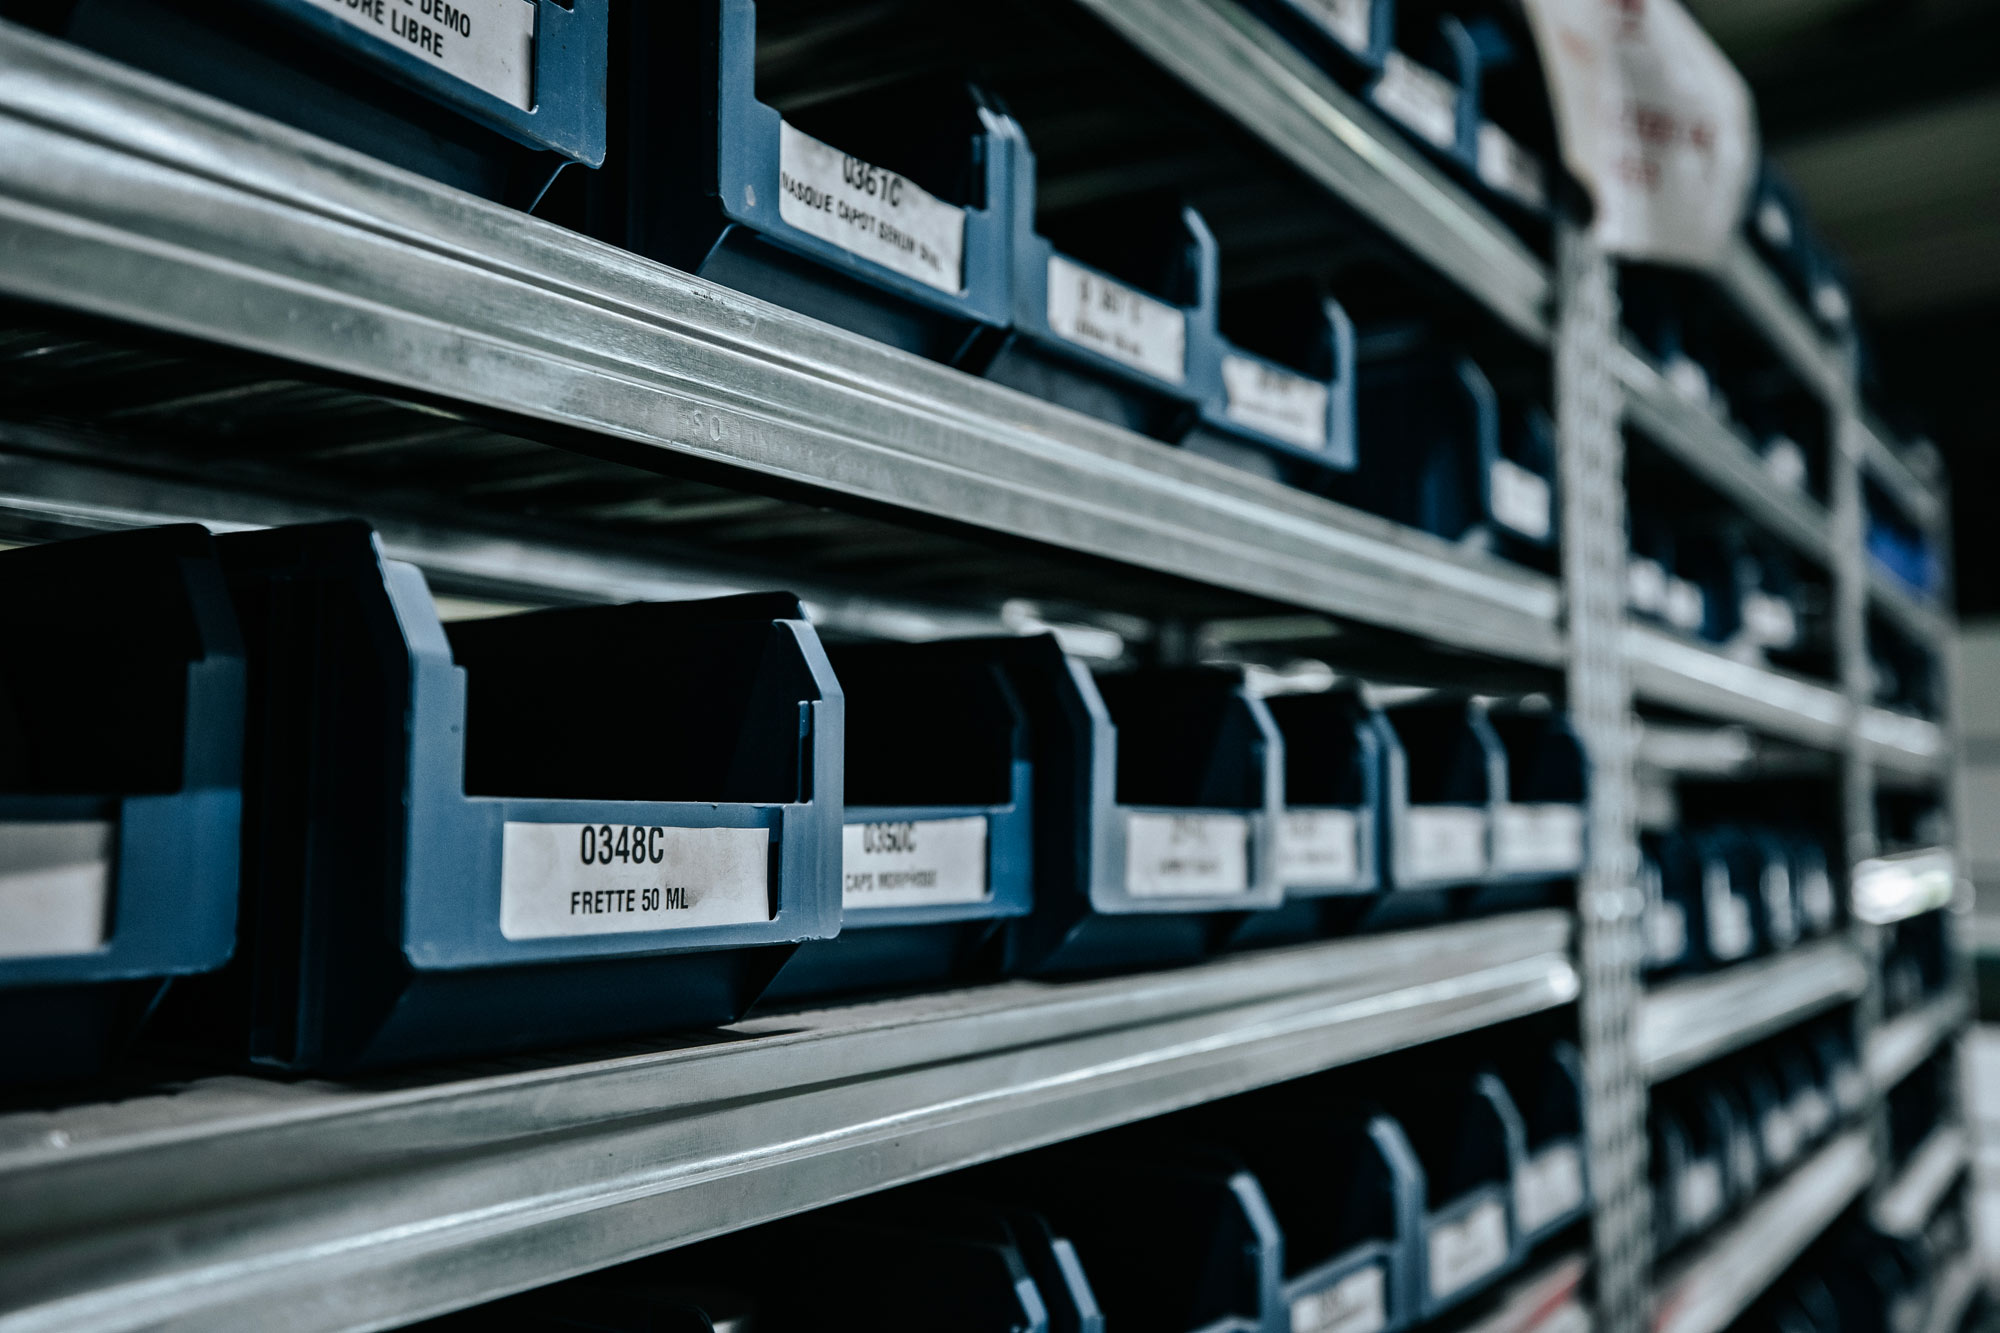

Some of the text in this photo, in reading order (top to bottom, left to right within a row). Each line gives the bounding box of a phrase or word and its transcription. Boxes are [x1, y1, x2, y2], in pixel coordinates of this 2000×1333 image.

[391, 9, 444, 58] LIBRE
[420, 0, 471, 38] DEMO
[782, 171, 833, 213] MASQUE
[843, 153, 903, 207] 0361C
[580, 825, 665, 865] 0348C
[570, 887, 689, 915] FRETTE 50 ML
[845, 872, 873, 893] CAPS
